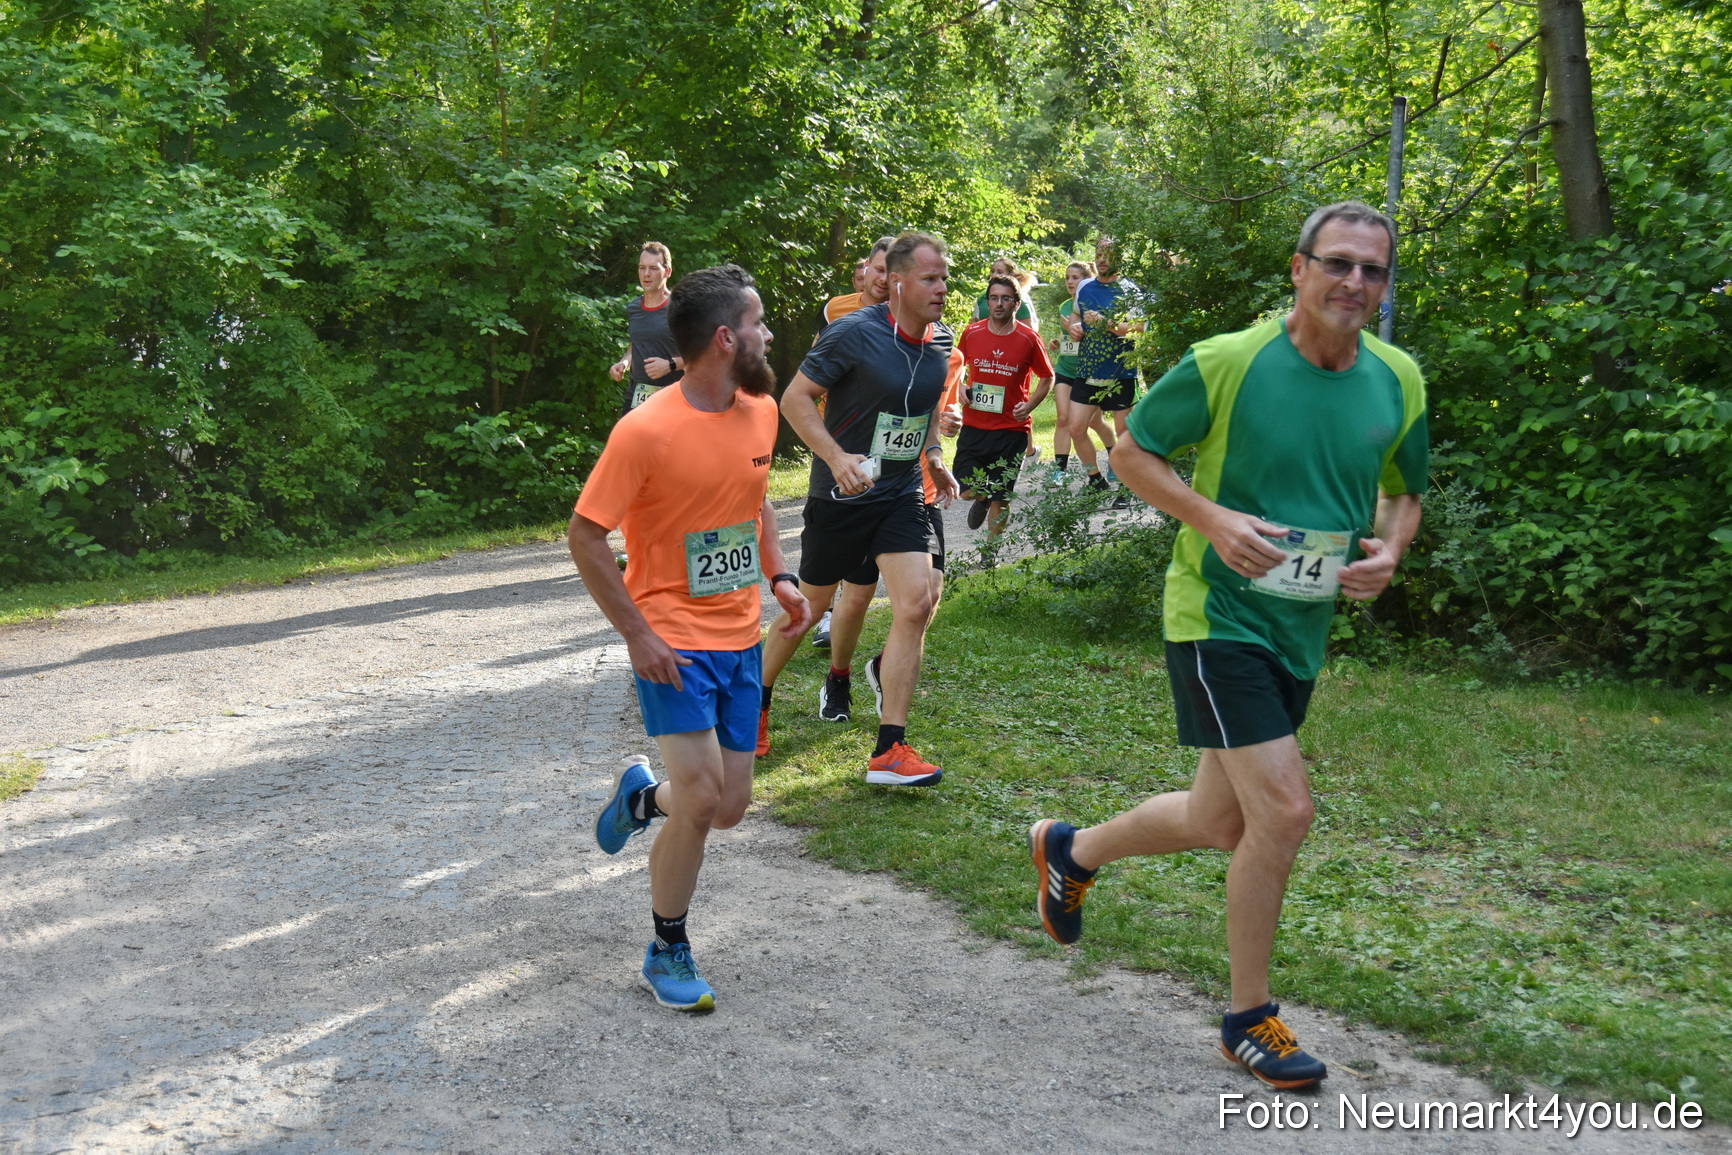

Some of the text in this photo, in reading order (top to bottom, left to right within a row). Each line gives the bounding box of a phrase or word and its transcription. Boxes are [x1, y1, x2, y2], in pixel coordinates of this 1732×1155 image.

[1065, 342, 1074, 350] 10
[995, 369, 1012, 377] FRISCH
[975, 392, 995, 405] 601
[883, 431, 921, 448] 1480
[697, 545, 752, 578] 2309
[1291, 555, 1323, 582] 14
